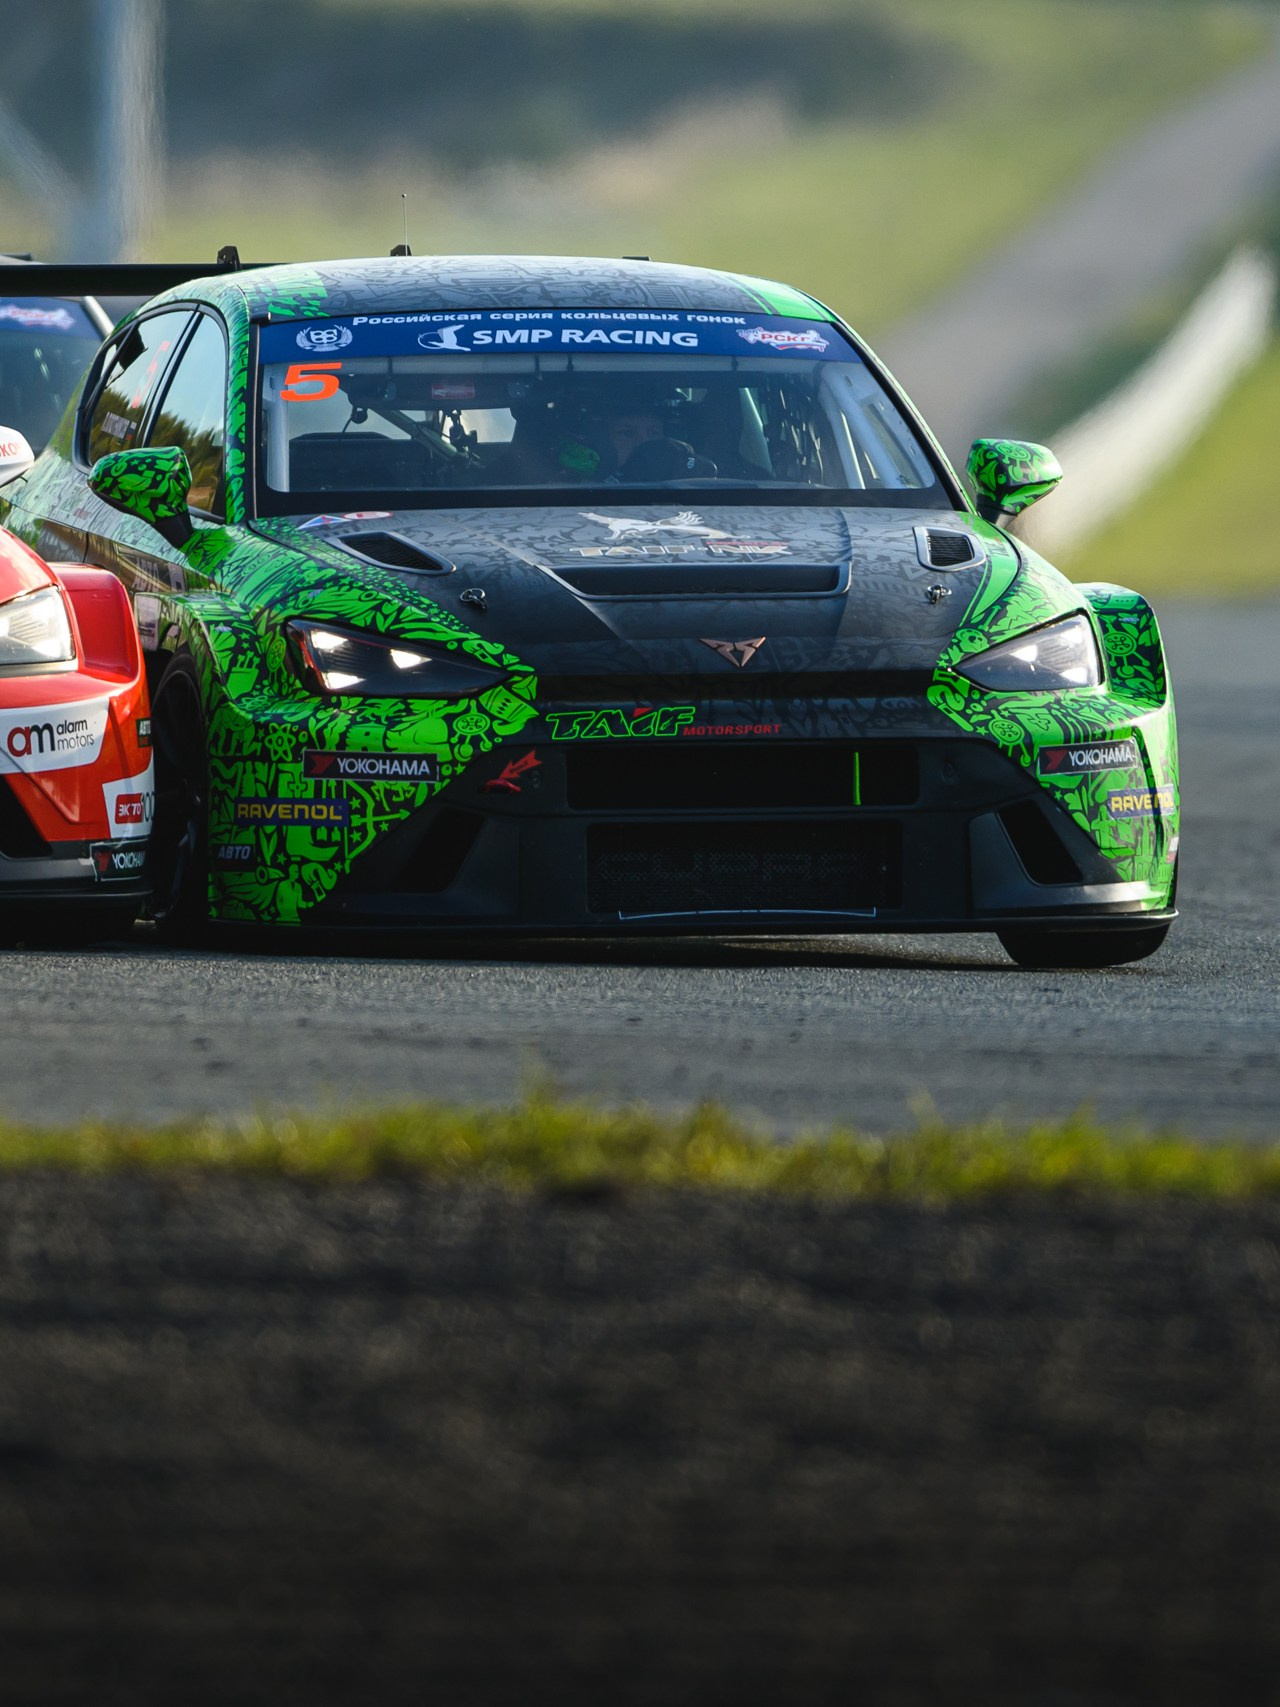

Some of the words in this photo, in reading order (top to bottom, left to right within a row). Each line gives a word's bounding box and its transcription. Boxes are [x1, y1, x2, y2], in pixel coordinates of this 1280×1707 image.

[352, 312, 482, 326] Российская
[489, 311, 554, 322] серия
[561, 311, 679, 322] кольцевых
[686, 313, 746, 325] гонок
[472, 329, 554, 345] SMP
[560, 329, 699, 347] RACING
[761, 333, 811, 342] РСКГ
[279, 362, 343, 402] 5
[56, 718, 88, 736] alarm
[683, 723, 782, 737] MOTORSPORT
[57, 731, 95, 751] motors
[1069, 745, 1134, 767] YOKOHAMA
[336, 757, 431, 776] YOKOHAMA
[118, 803, 142, 817] ЭКТО
[237, 803, 343, 821] RAVENOL
[1111, 793, 1174, 813] RAVENOL
[218, 845, 252, 860] АВТО
